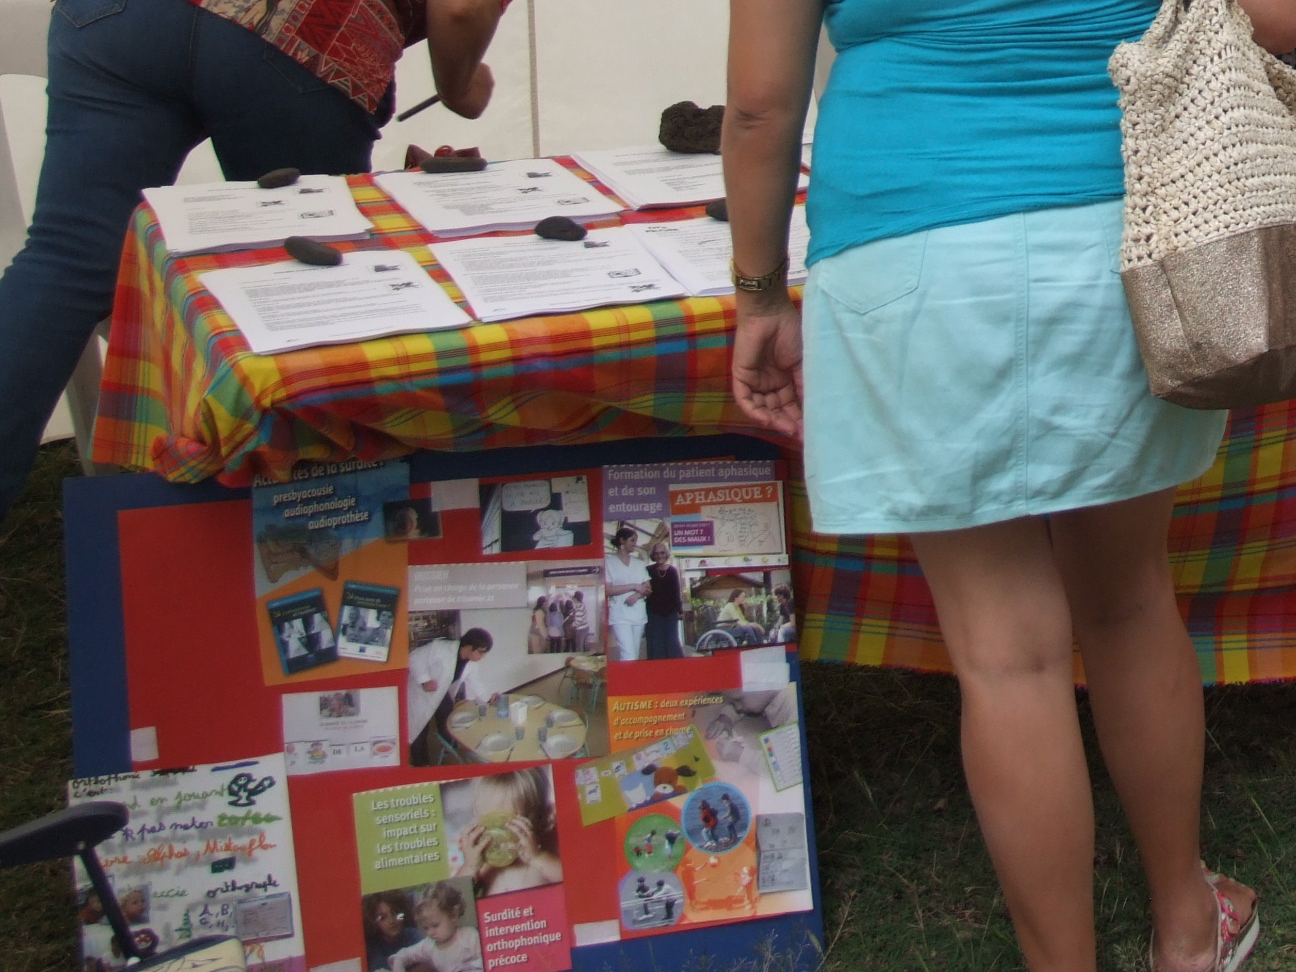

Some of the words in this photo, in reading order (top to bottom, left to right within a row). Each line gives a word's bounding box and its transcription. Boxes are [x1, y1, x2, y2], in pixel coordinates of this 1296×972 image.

[608, 467, 661, 480] Formation
[663, 467, 676, 478] du
[679, 466, 717, 481] patient
[718, 465, 771, 480] aphasique
[273, 484, 334, 505] presbyacousie
[608, 485, 619, 496] et
[622, 485, 634, 496] de
[637, 486, 656, 495] son
[674, 487, 763, 505] APHASIQUE
[284, 496, 356, 517] audiophonologie
[608, 501, 663, 514] entourage
[308, 510, 369, 529] audioprothèse
[613, 700, 653, 712] AUTISME
[660, 699, 679, 708] deux
[680, 695, 724, 708] expériences
[613, 712, 685, 726] d'accompagnement
[614, 731, 622, 740] et
[623, 731, 632, 739] de
[634, 729, 653, 740] prise
[371, 800, 389, 810] Les
[391, 793, 435, 808] troubles
[375, 808, 430, 825] sensoriels
[383, 824, 418, 839] impact
[420, 822, 437, 833] sur
[377, 843, 393, 854] les
[395, 836, 438, 851] troubles
[375, 851, 440, 870] alimentaires
[484, 907, 521, 923] Surdité
[523, 905, 534, 916] et
[485, 919, 547, 937] intervention
[486, 931, 562, 952] orthophonique
[488, 954, 528, 970] précoce
